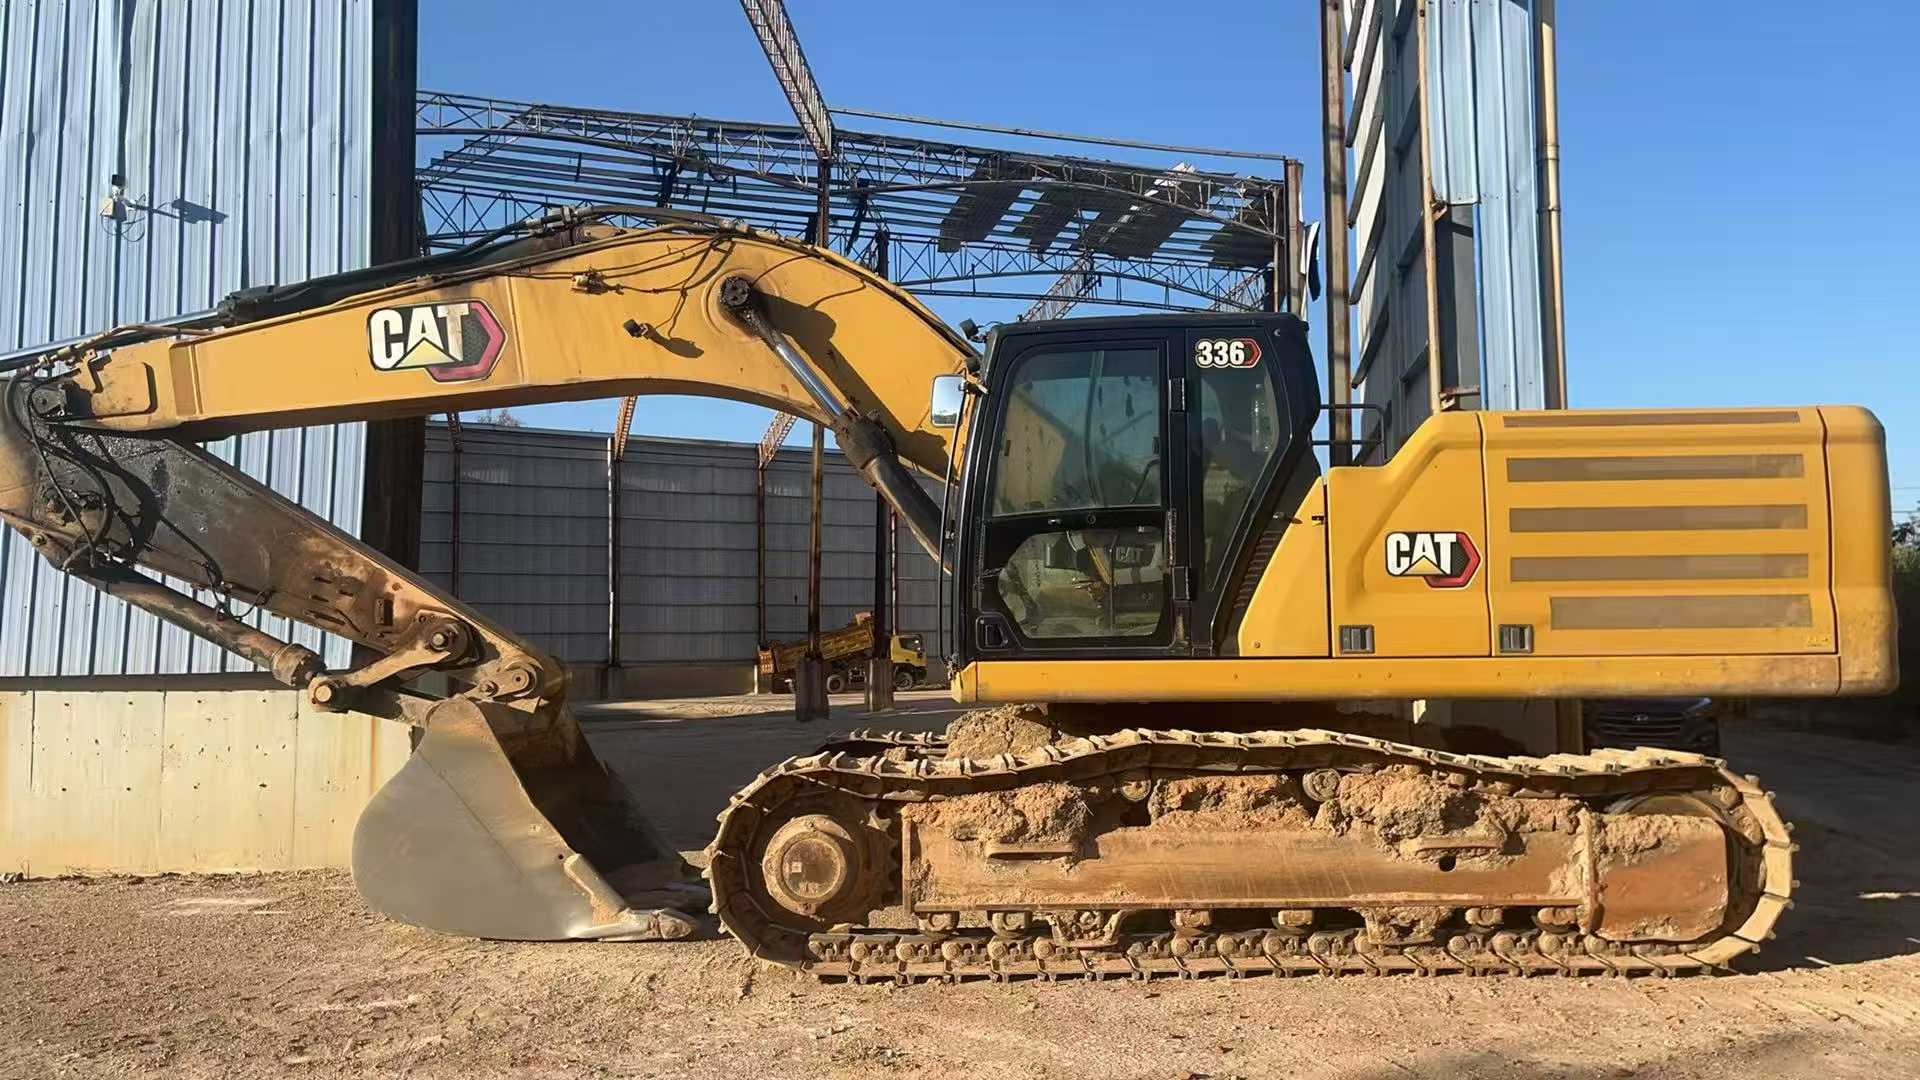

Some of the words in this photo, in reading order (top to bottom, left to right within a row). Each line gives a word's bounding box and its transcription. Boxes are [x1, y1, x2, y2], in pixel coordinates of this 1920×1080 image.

[370, 303, 469, 368] CAT
[1198, 341, 1245, 365] 336
[1387, 533, 1456, 575] CAT
